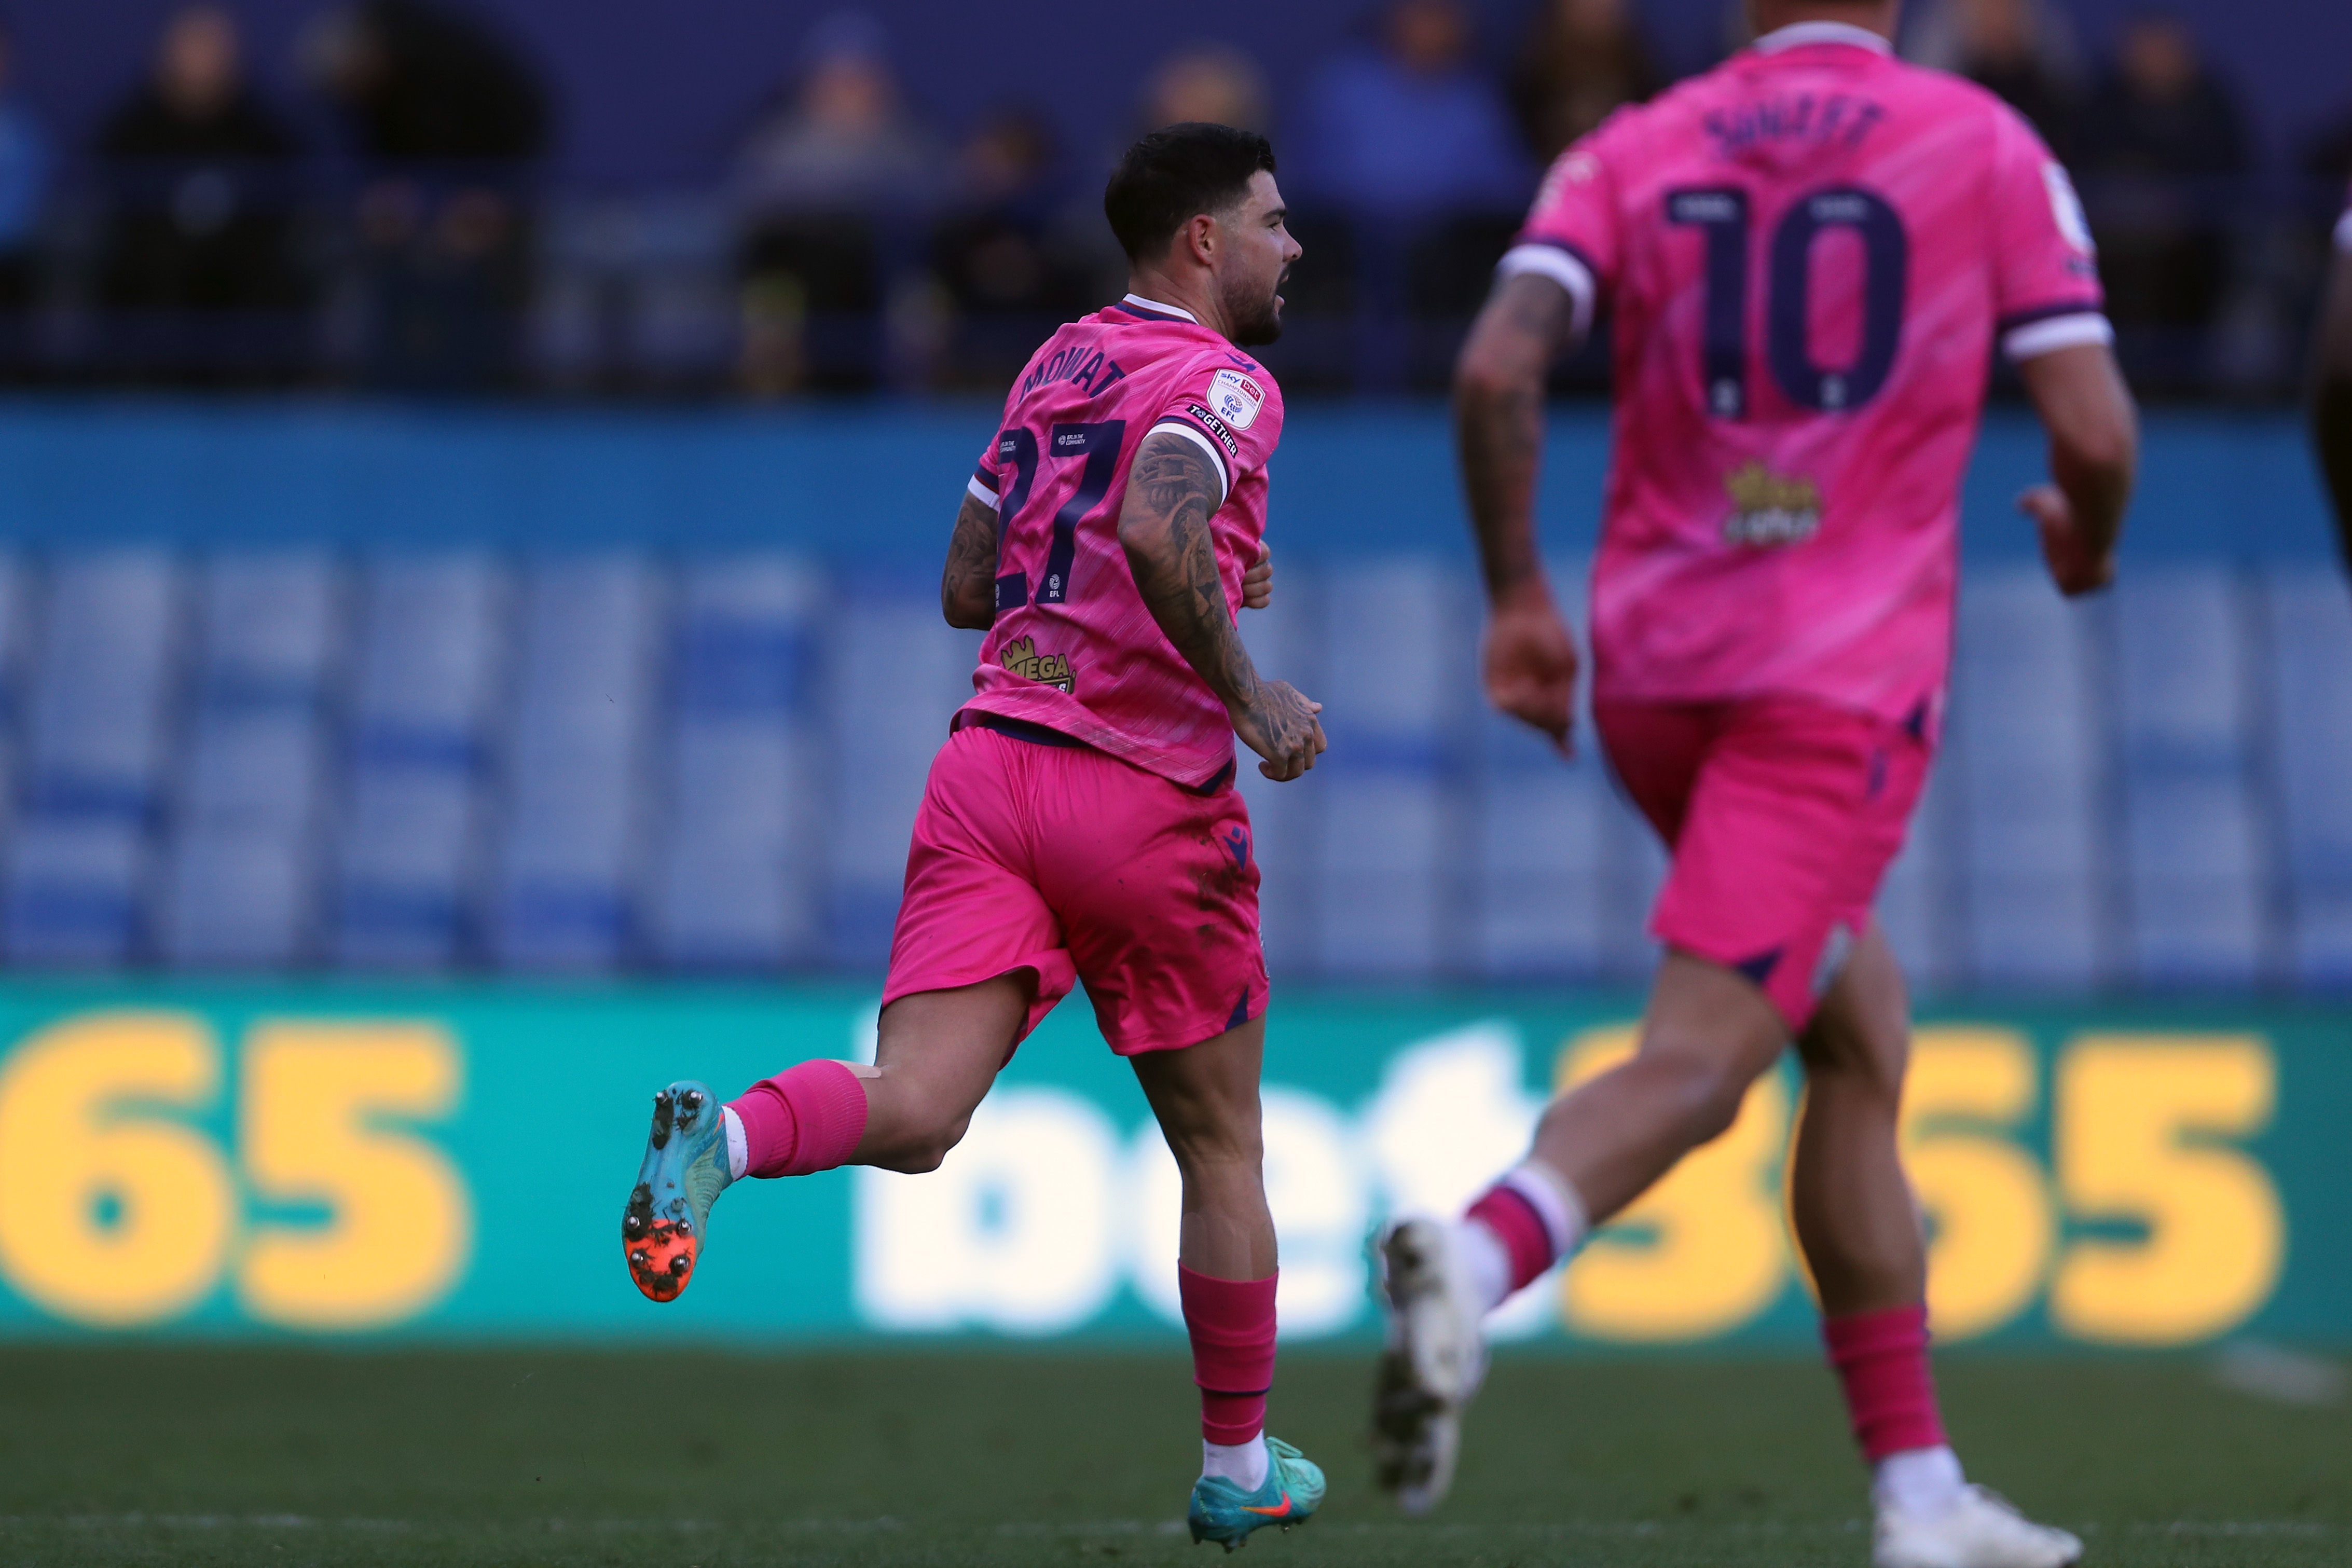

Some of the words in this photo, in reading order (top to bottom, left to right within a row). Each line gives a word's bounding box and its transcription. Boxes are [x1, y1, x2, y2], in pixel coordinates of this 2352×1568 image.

[1666, 184, 1906, 417] 10
[1017, 347, 1126, 406] MOWAT
[1217, 379, 1257, 406] CHAMPIONSHIP
[1220, 373, 1241, 383] sky
[1243, 380, 1260, 399] bet
[1190, 405, 1237, 456] TOGETHER
[1221, 407, 1235, 422] EFL
[996, 420, 1126, 612] 27
[1009, 654, 1069, 680] MEGA
[0, 1011, 473, 1330] 65
